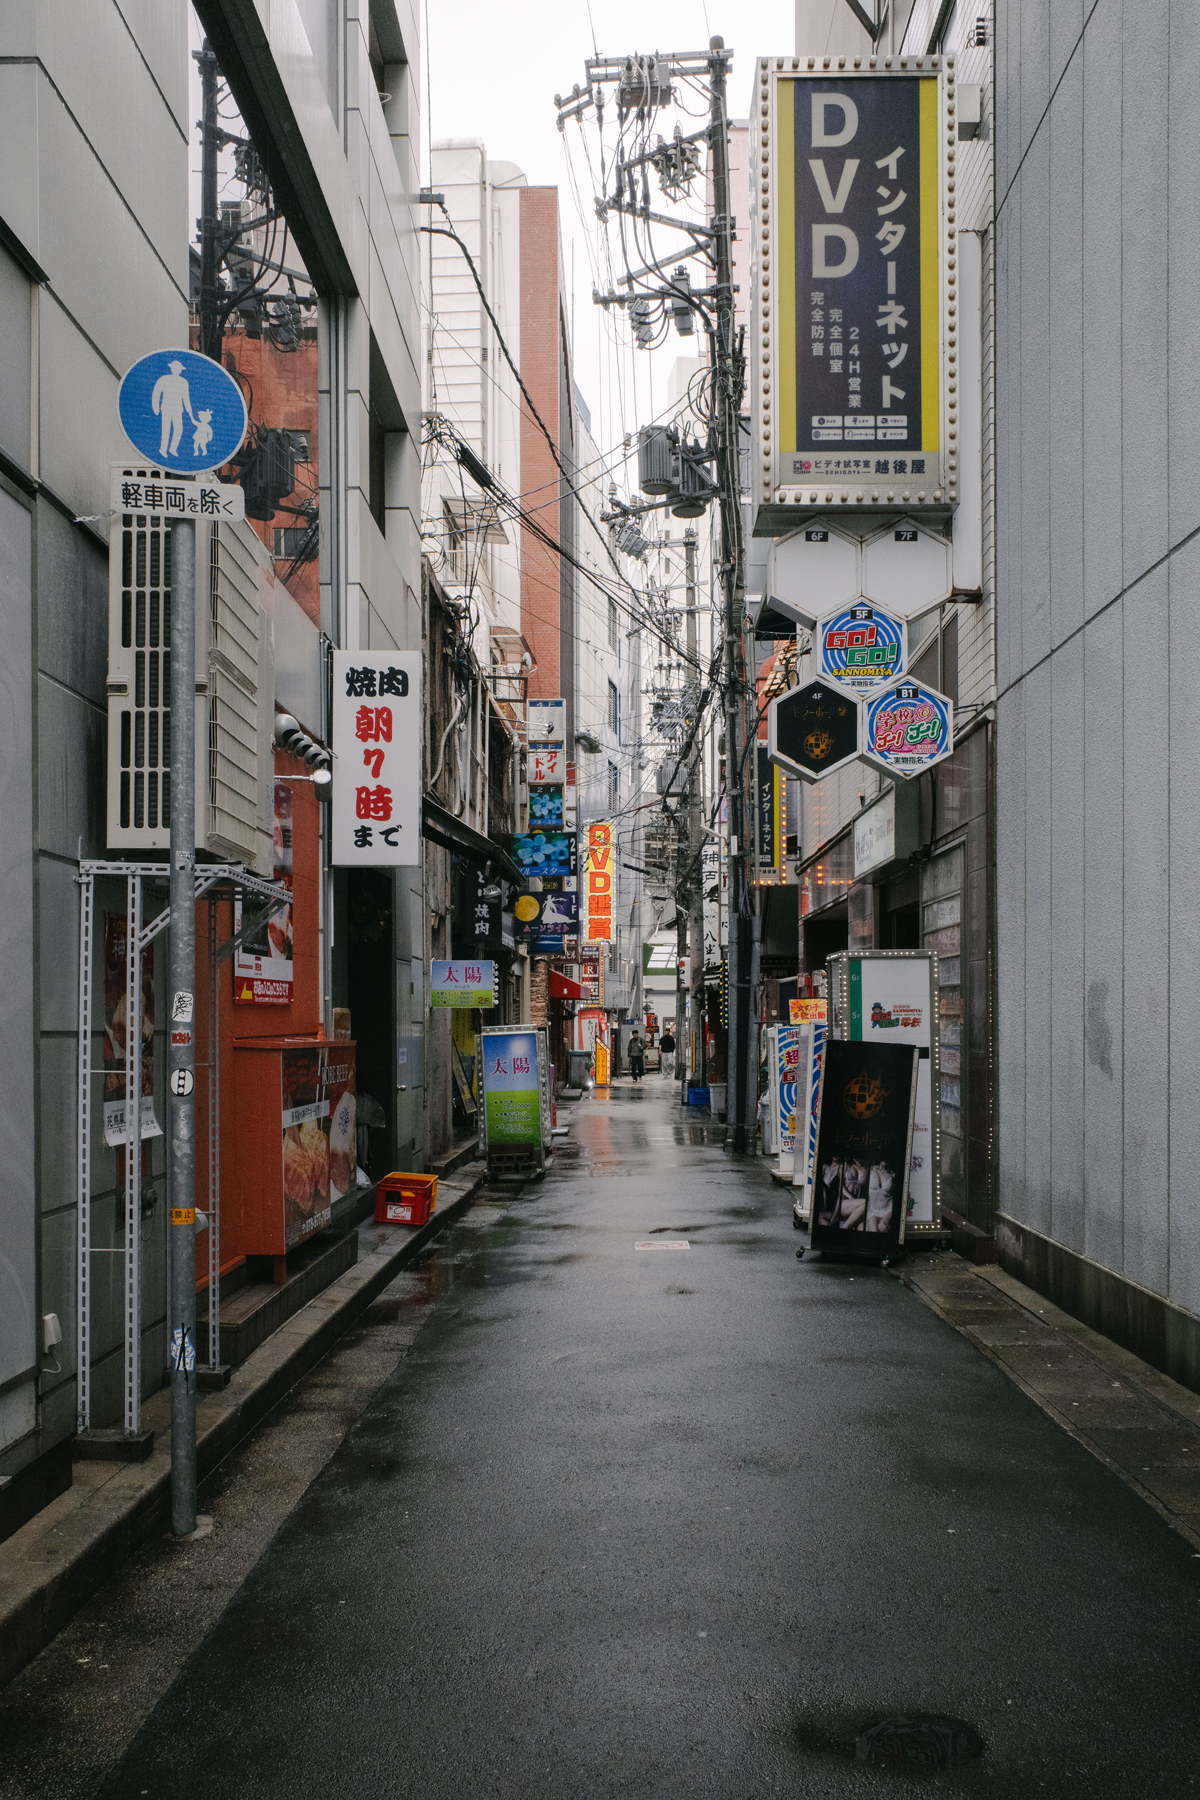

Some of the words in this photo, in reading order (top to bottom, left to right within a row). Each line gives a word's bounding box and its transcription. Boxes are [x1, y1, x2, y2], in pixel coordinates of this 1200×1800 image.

[808, 93, 860, 278] DVD
[875, 146, 909, 409] インターネット
[811, 291, 825, 356] 完全防音
[829, 308, 843, 373] 完全個室
[848, 327, 862, 408] 24H営業
[814, 460, 871, 469] ビデオ試写室
[875, 459, 926, 475] 越後屋
[121, 482, 233, 515] 軽車両を除く
[811, 532, 824, 541] 6F
[900, 532, 913, 541] 7F
[856, 610, 868, 619] 5F
[825, 625, 878, 650] GO!
[846, 642, 898, 667] GO!
[345, 666, 409, 697] 焼肉
[832, 667, 893, 677] SANNOMIYA
[812, 692, 823, 700] 4F
[901, 689, 913, 698] B1
[876, 707, 914, 731] 学校
[893, 756, 924, 765] 実物指名
[762, 783, 771, 852] インターネット
[353, 825, 402, 848] まで
[570, 838, 577, 870] 2F
[702, 850, 719, 899] 神戸
[571, 895, 577, 914] 1F
[442, 966, 482, 984] 太陽
[477, 996, 490, 1005] 2F
[797, 1003, 820, 1012] 女の子
[490, 1057, 531, 1075] 太陽
